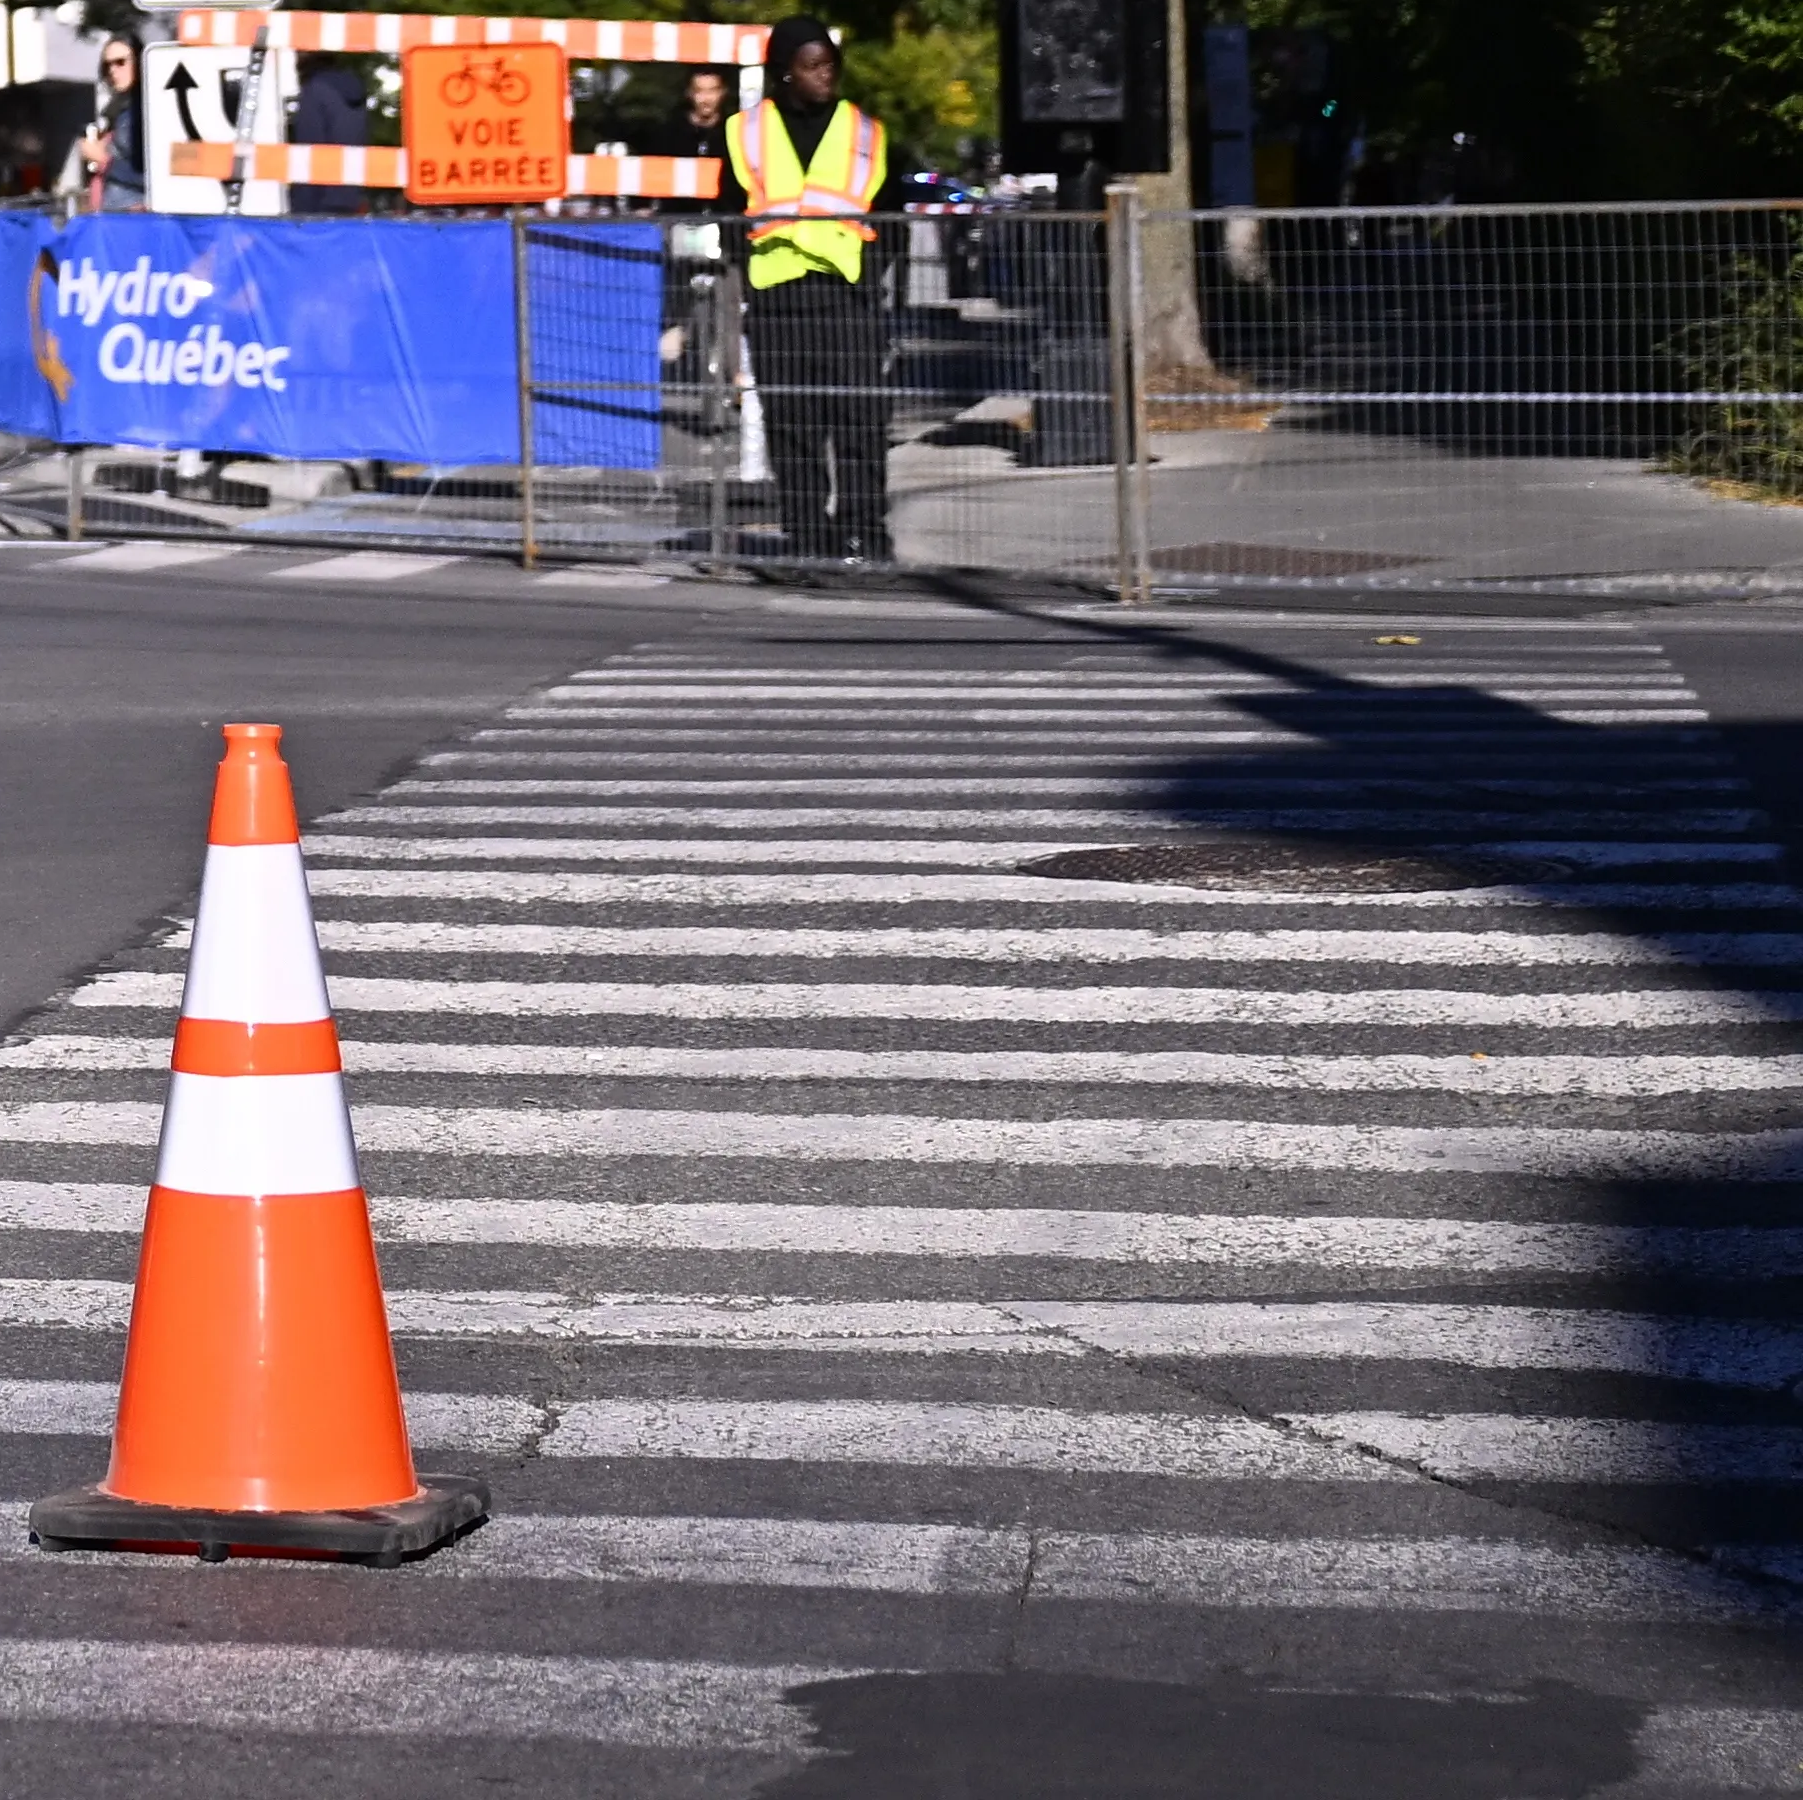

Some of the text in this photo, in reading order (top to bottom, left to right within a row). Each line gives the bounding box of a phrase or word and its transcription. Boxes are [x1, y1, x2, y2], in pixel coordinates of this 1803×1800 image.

[447, 119, 526, 149] VOIE
[419, 151, 556, 188] BARRÉE
[98, 324, 291, 392] Québec
